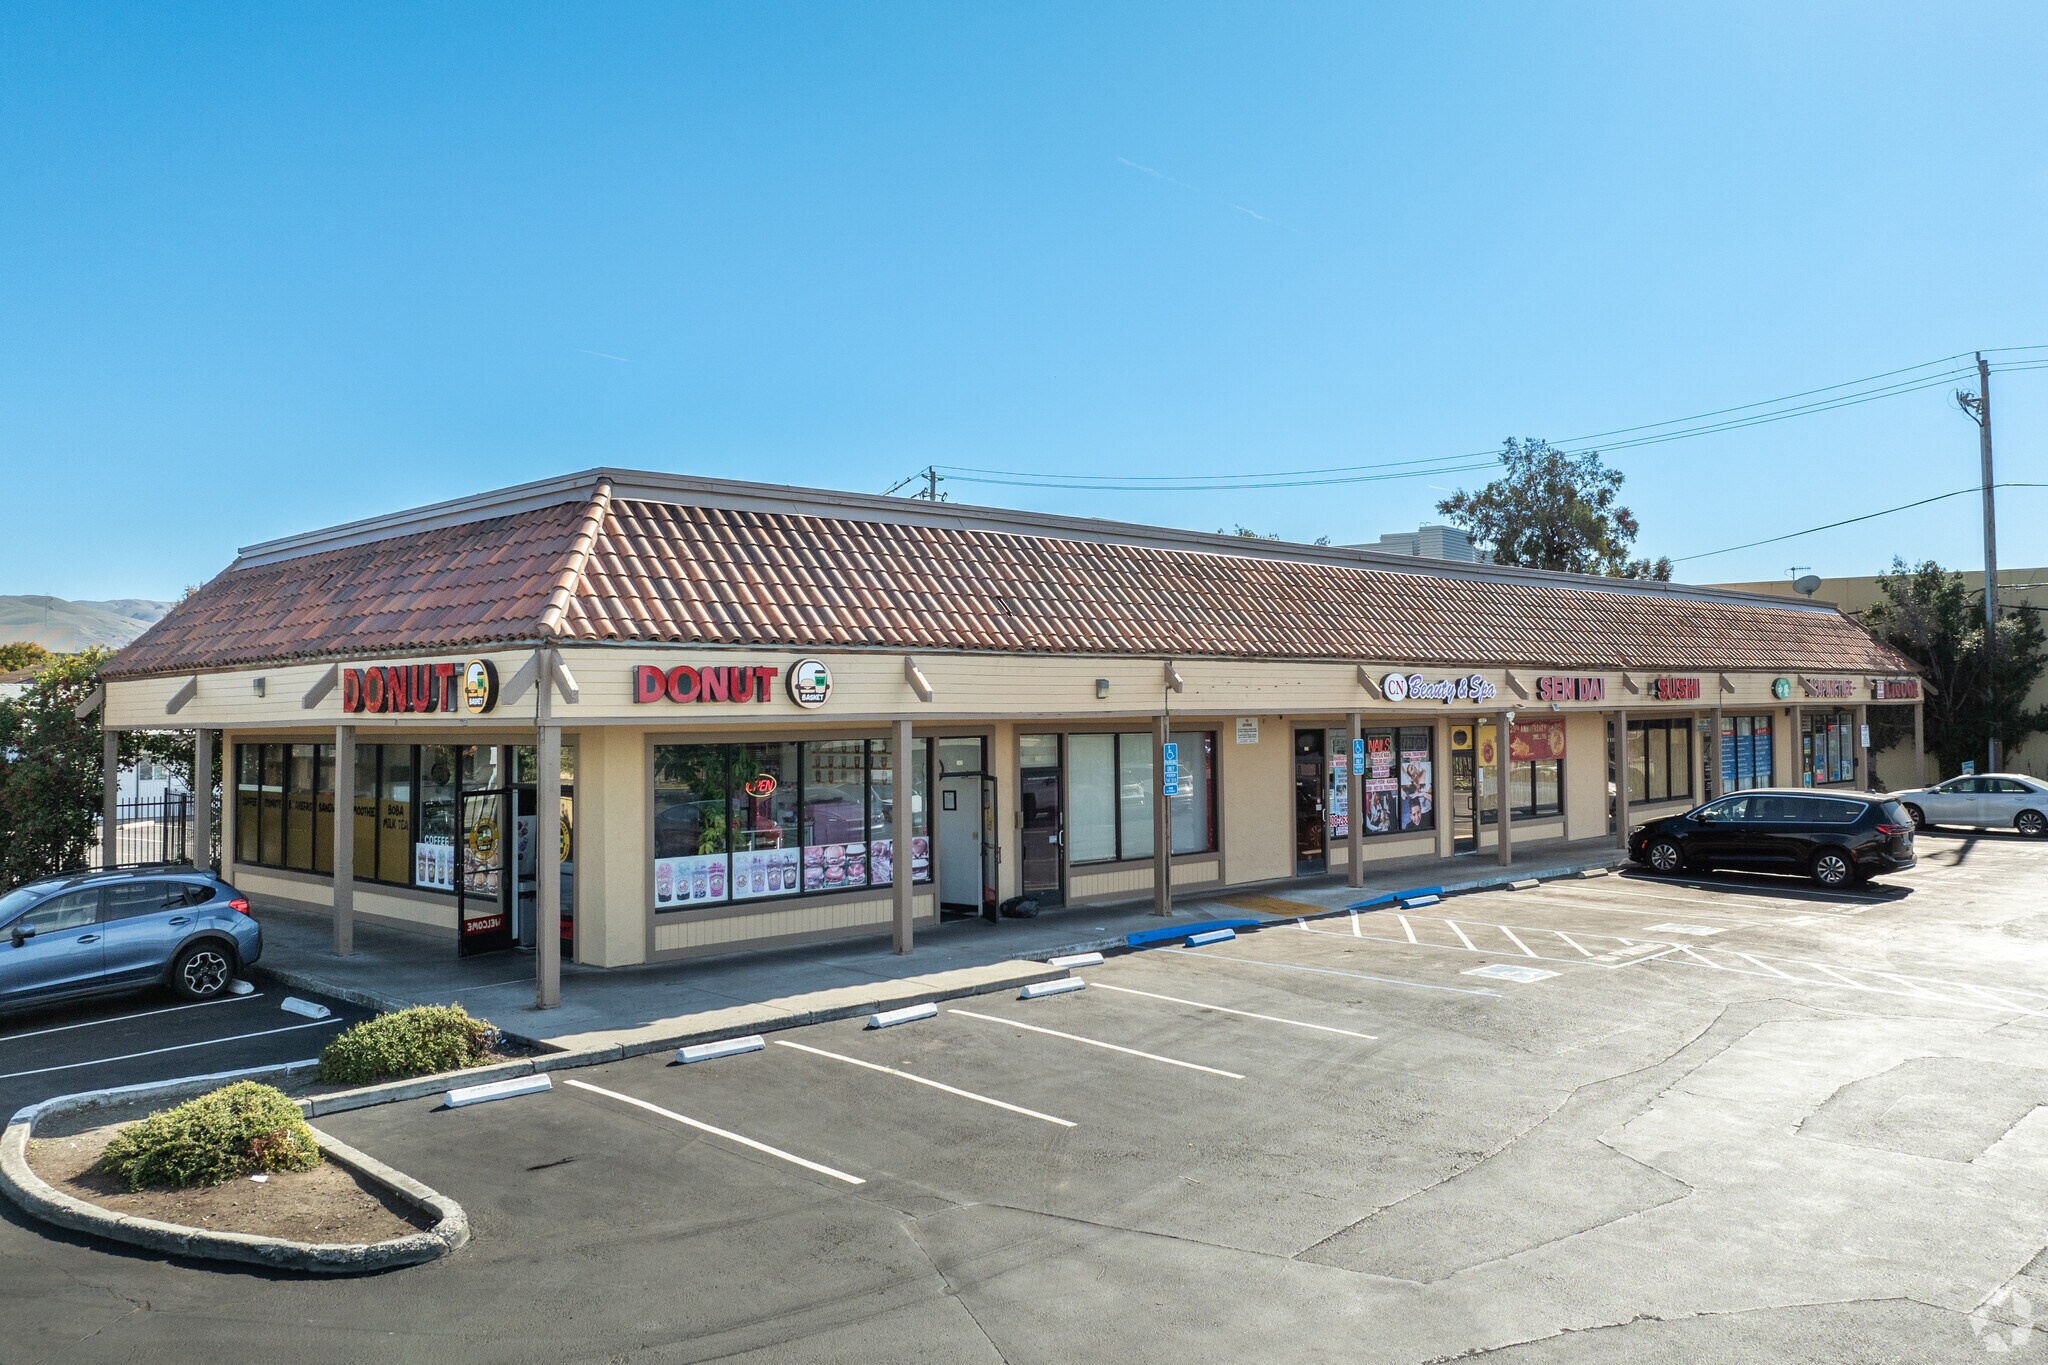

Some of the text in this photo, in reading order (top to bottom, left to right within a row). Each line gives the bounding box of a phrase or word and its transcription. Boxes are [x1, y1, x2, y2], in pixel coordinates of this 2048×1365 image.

[343, 662, 455, 713] DONUT
[637, 665, 778, 704] DONUT
[1388, 680, 1404, 695] CN
[1408, 673, 1497, 704] Beauty & Spa
[1541, 677, 1605, 700] SEN DAI
[1658, 678, 1700, 700] SUSHI
[469, 697, 483, 705] BASKET
[802, 693, 824, 701] BASKET
[1368, 737, 1391, 753] NAILS
[388, 804, 404, 816] BOBA
[383, 818, 396, 830] MILK
[424, 834, 449, 845] COFFEE
